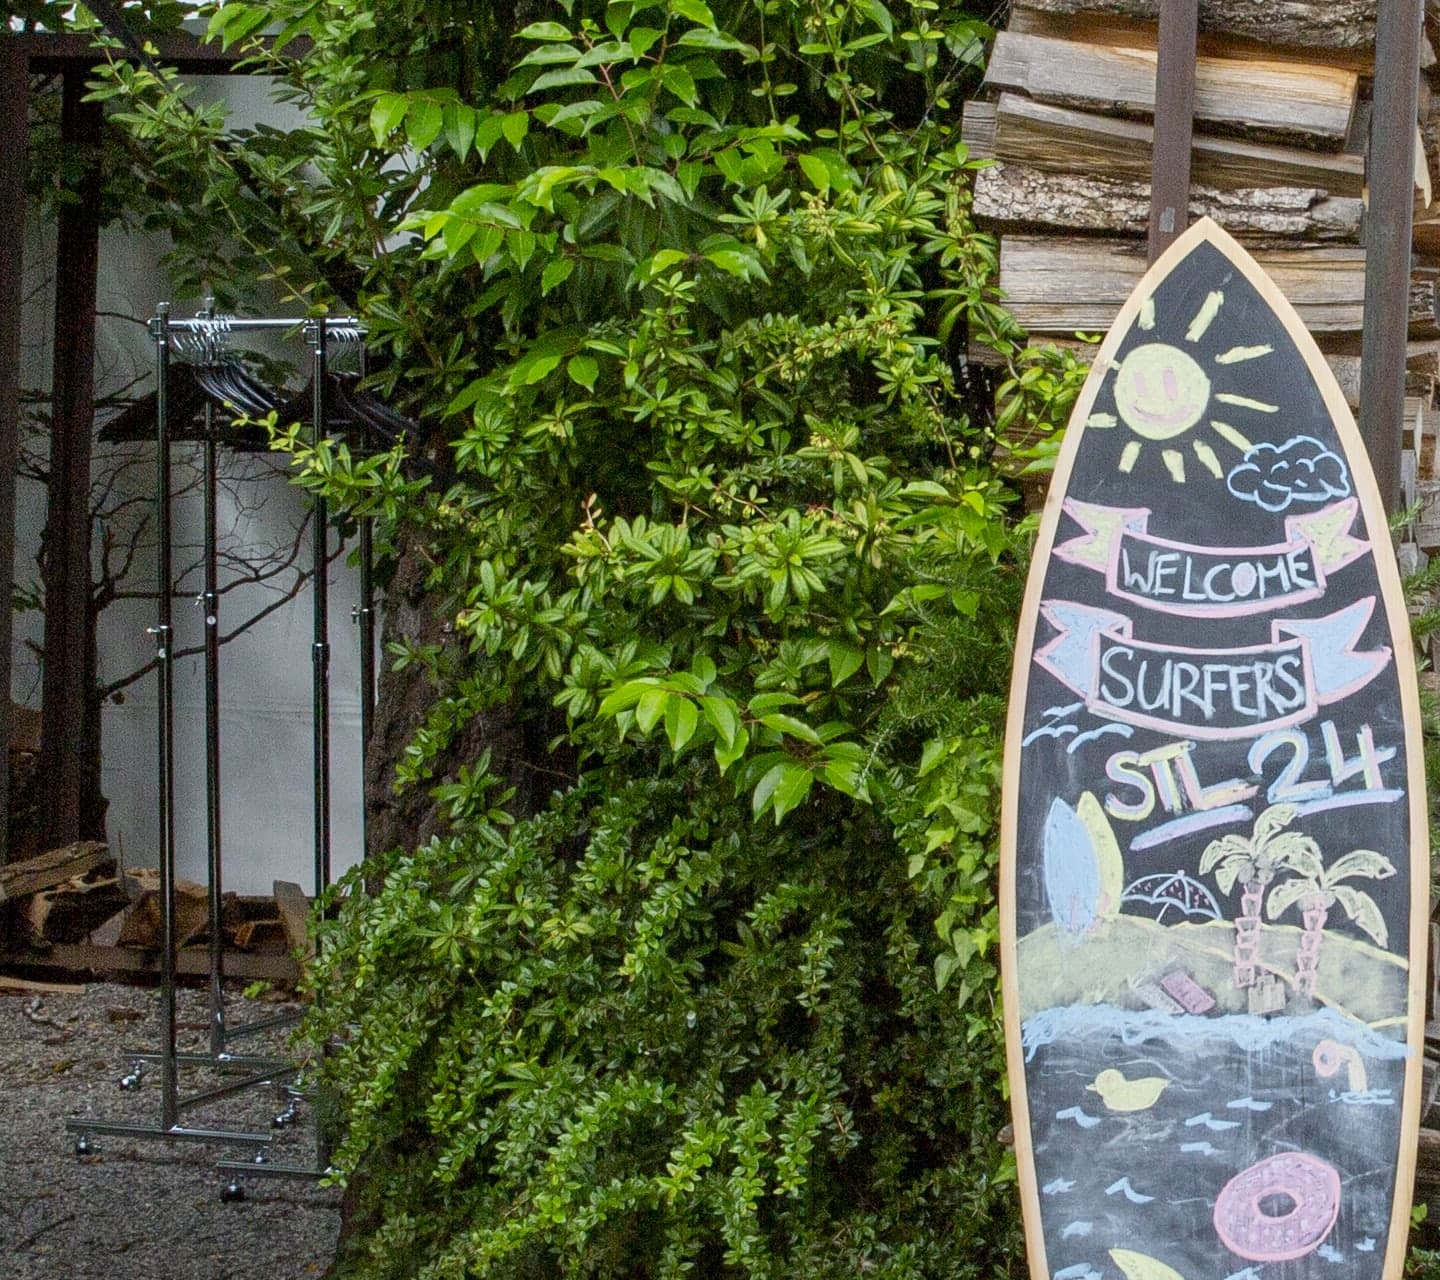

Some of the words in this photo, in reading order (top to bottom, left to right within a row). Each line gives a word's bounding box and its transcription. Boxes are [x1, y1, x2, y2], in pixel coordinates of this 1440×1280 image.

[1122, 546, 1319, 601] WELCOME
[1100, 646, 1305, 718] SURFERS
[1105, 740, 1259, 820] STL
[1247, 720, 1397, 804] 24
